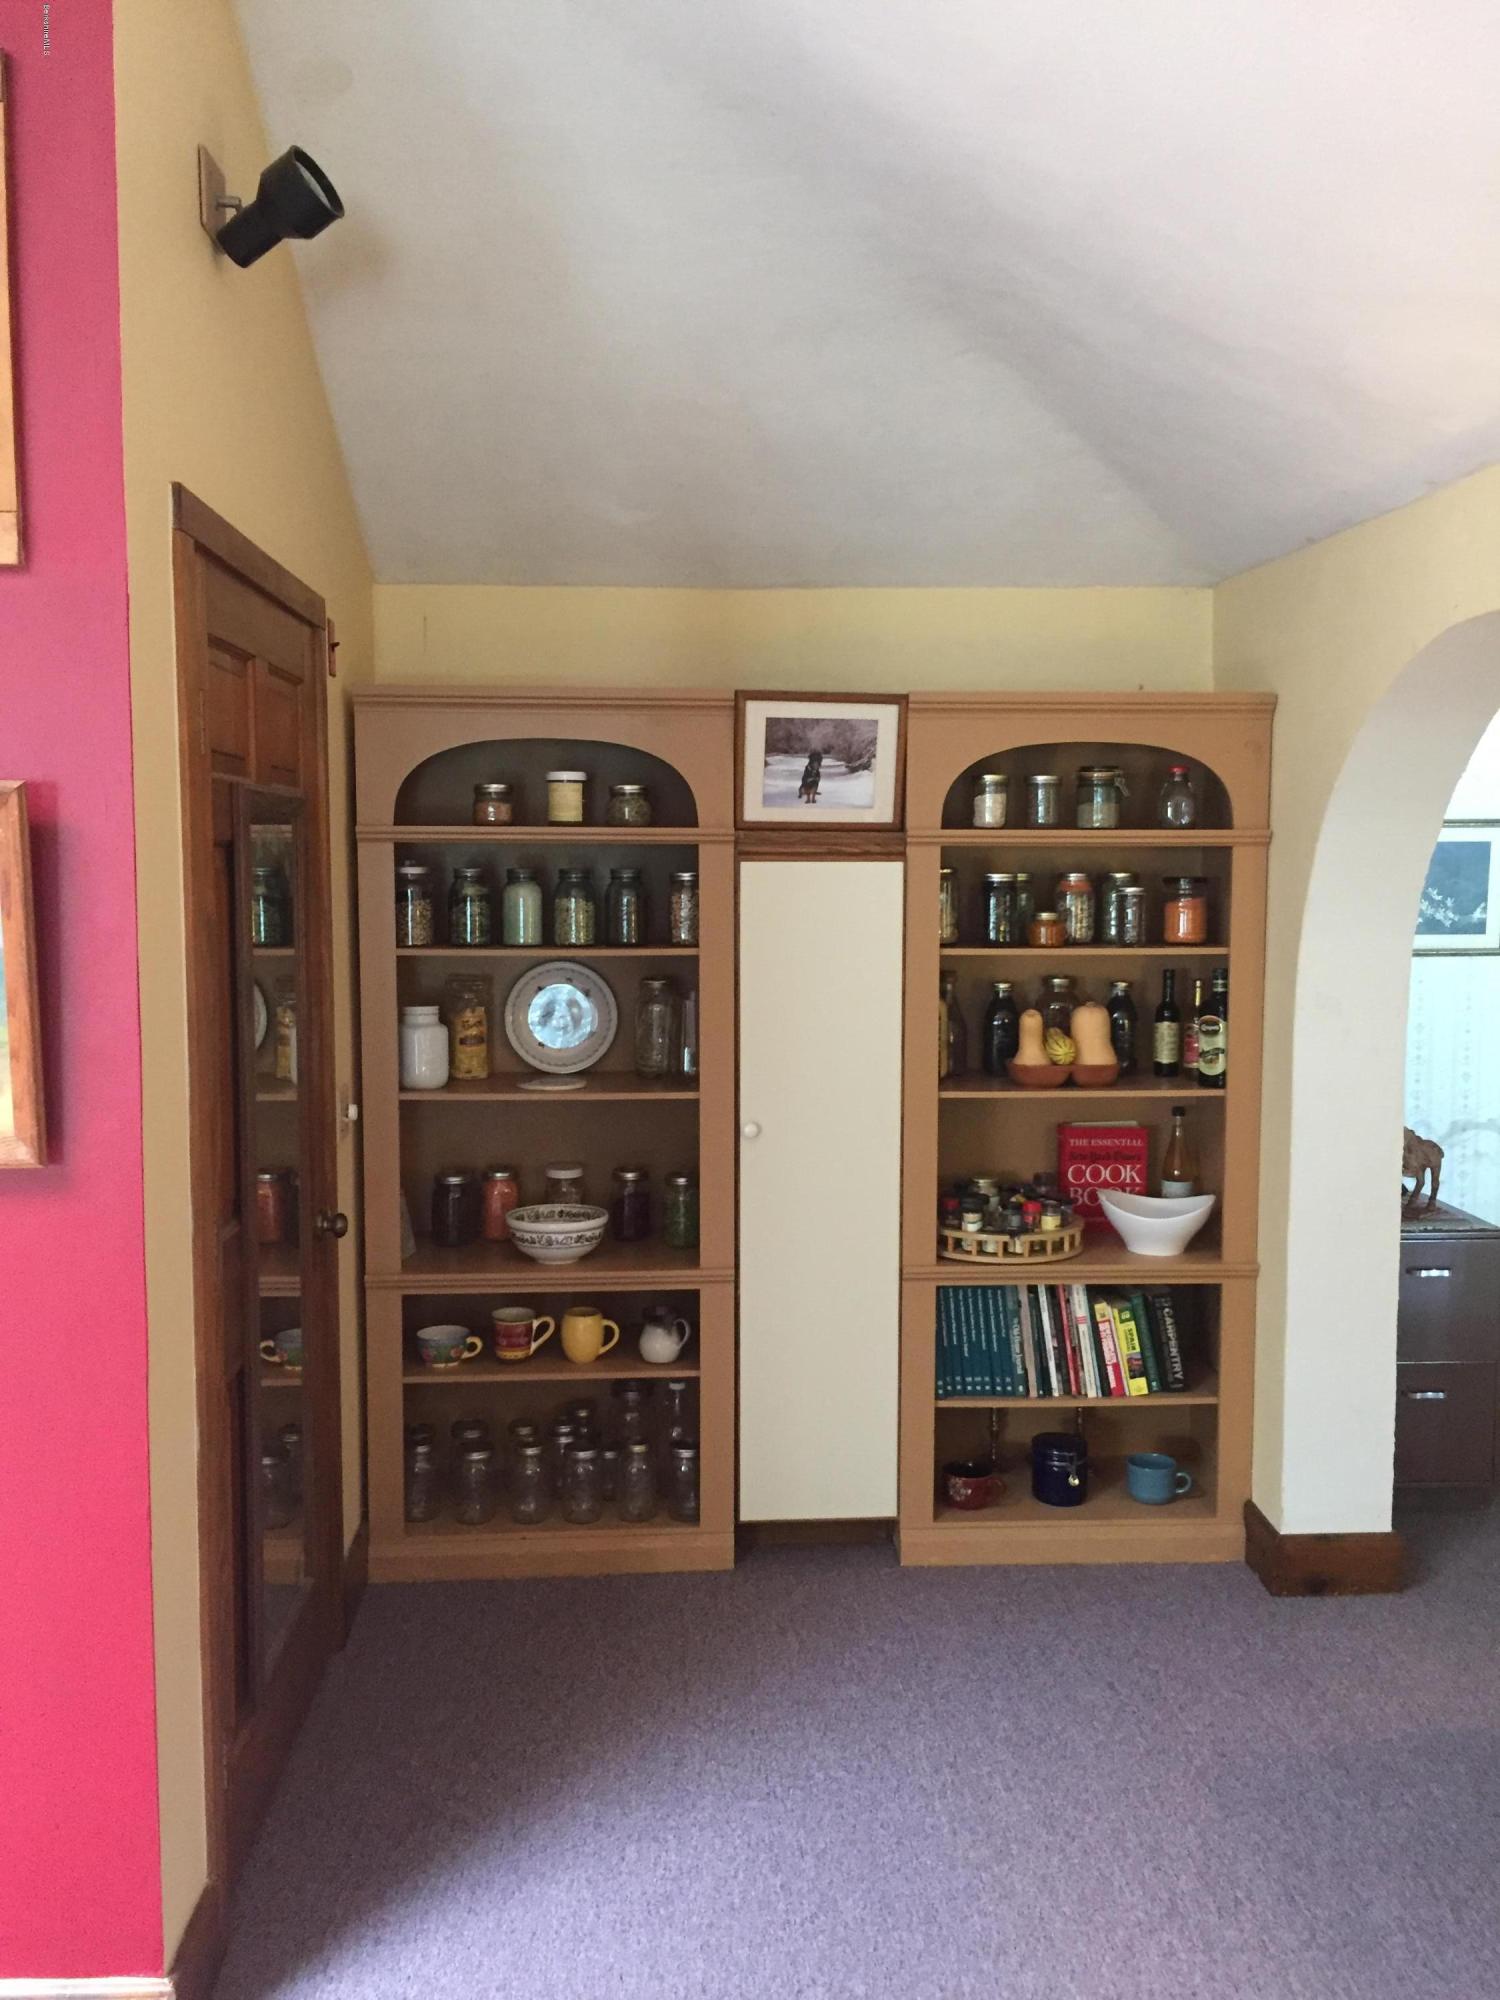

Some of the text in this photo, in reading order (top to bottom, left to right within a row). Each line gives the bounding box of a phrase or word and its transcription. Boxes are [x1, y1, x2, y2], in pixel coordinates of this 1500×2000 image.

[1070, 1138, 1143, 1147] THE ESSENTIAL
[1067, 1163, 1143, 1184] COOK
[1162, 1307, 1185, 1381] CARPENTRY
